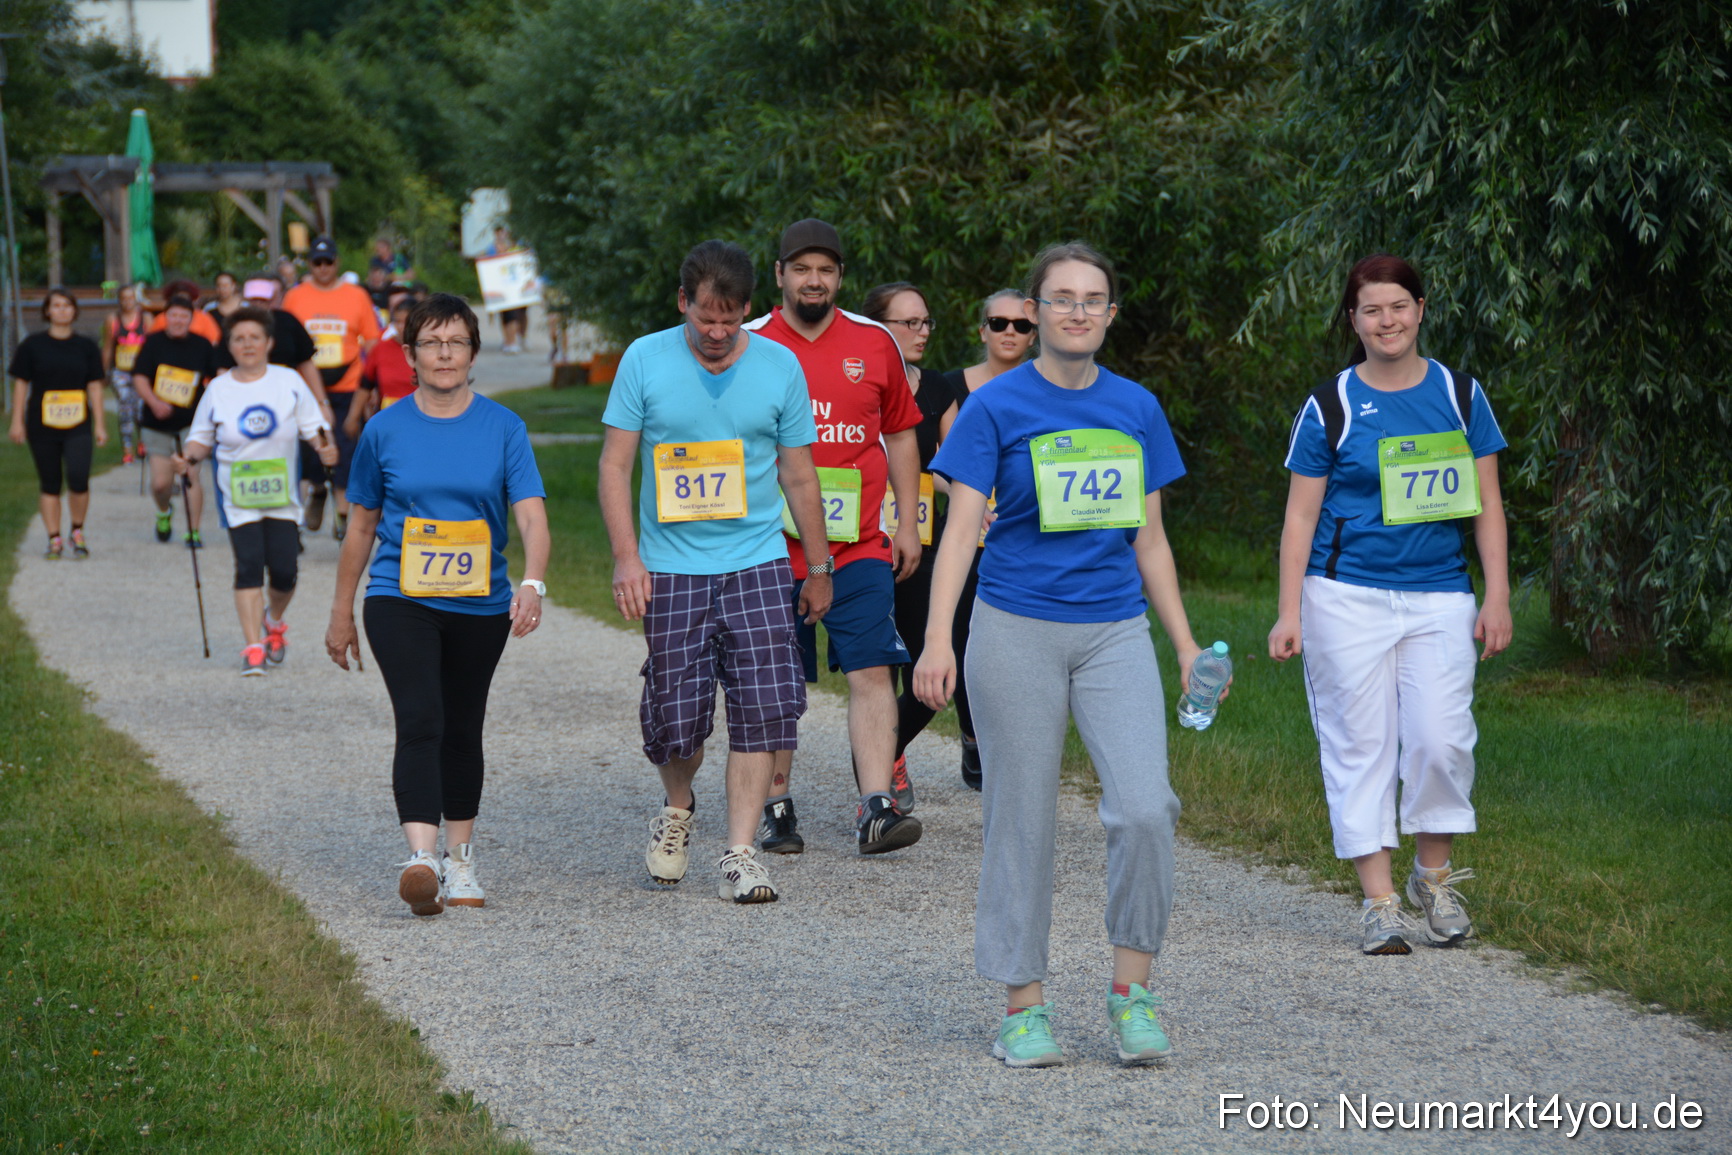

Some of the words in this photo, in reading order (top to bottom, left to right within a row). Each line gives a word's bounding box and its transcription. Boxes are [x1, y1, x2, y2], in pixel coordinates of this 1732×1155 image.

[810, 399, 832, 419] ly
[1359, 408, 1378, 417] erima
[236, 478, 282, 497] 1483
[674, 472, 727, 499] 817
[1057, 468, 1122, 502] 742
[1400, 467, 1459, 499] 770
[1071, 508, 1096, 516] Claudia
[1096, 507, 1111, 515] Wolf
[420, 551, 473, 576] 779
